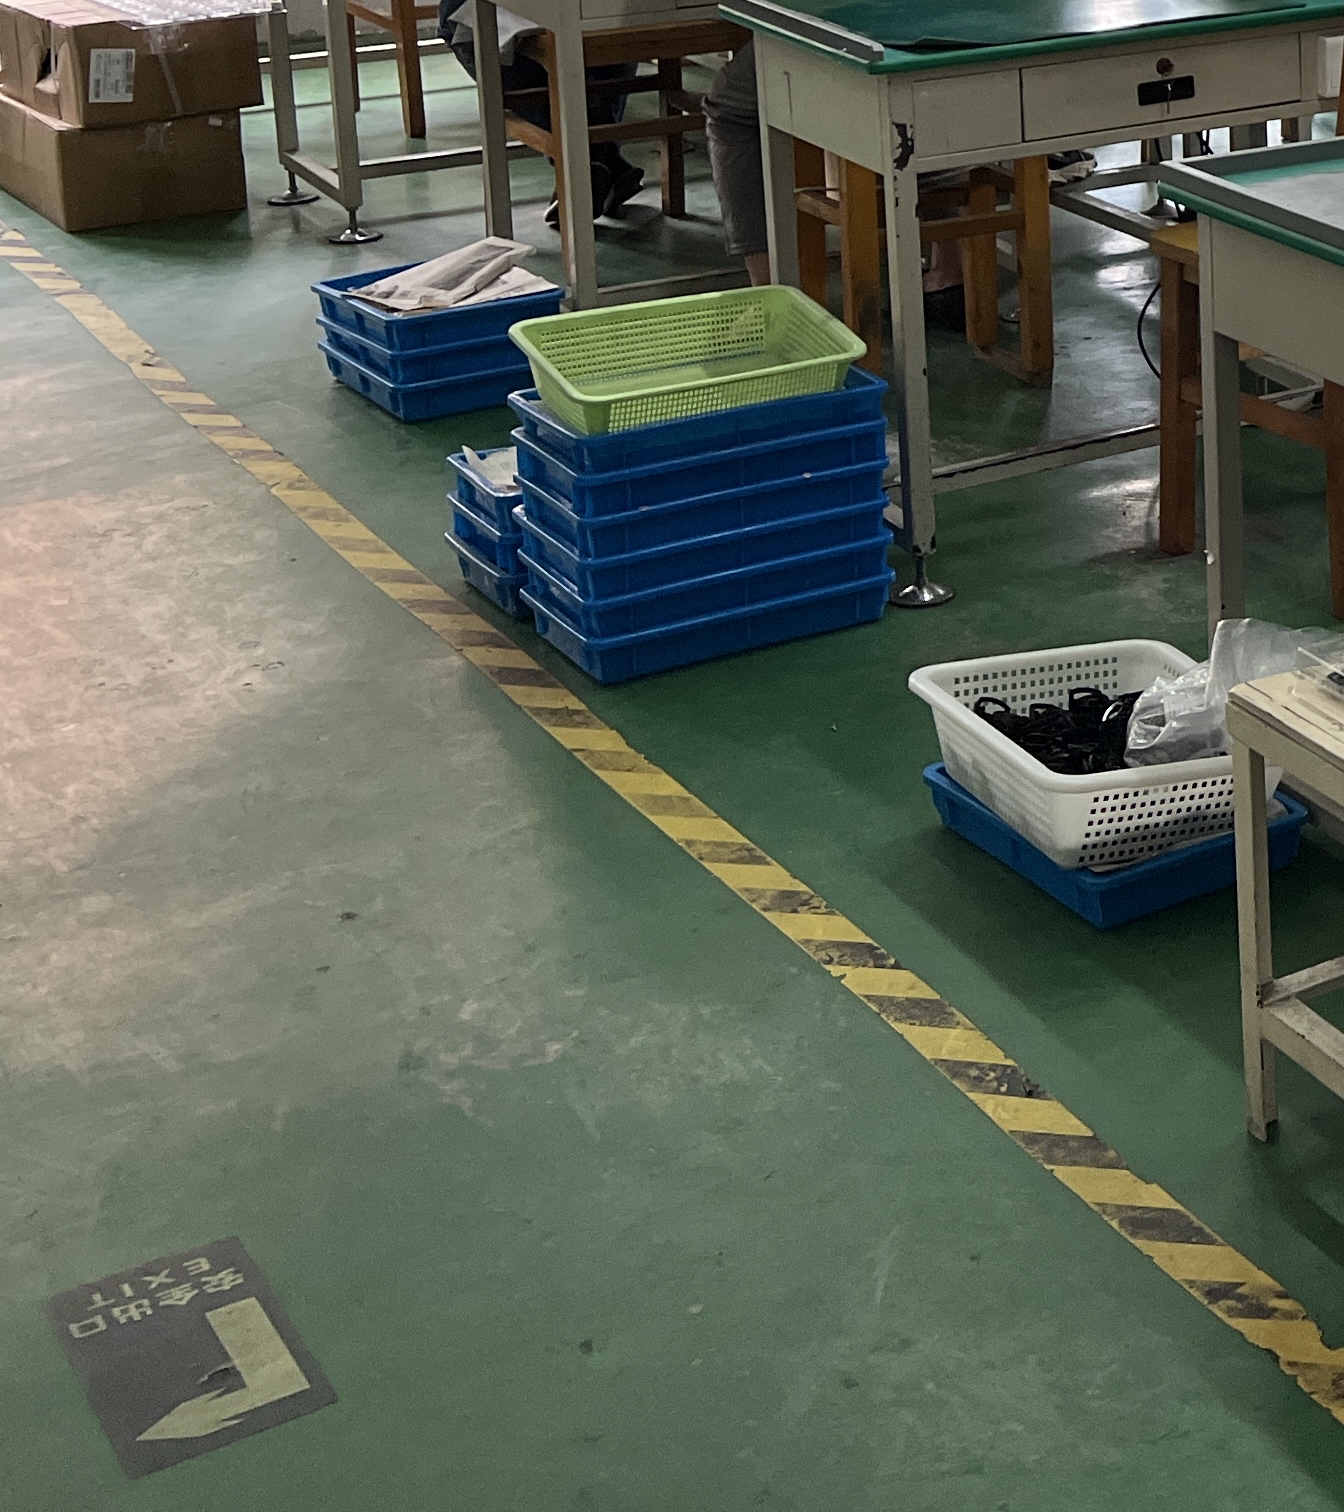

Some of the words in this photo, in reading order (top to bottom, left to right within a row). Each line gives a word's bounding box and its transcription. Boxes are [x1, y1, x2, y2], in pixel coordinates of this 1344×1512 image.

[67, 1266, 246, 1339] 安全出口
[87, 1256, 213, 1312] EXIT
